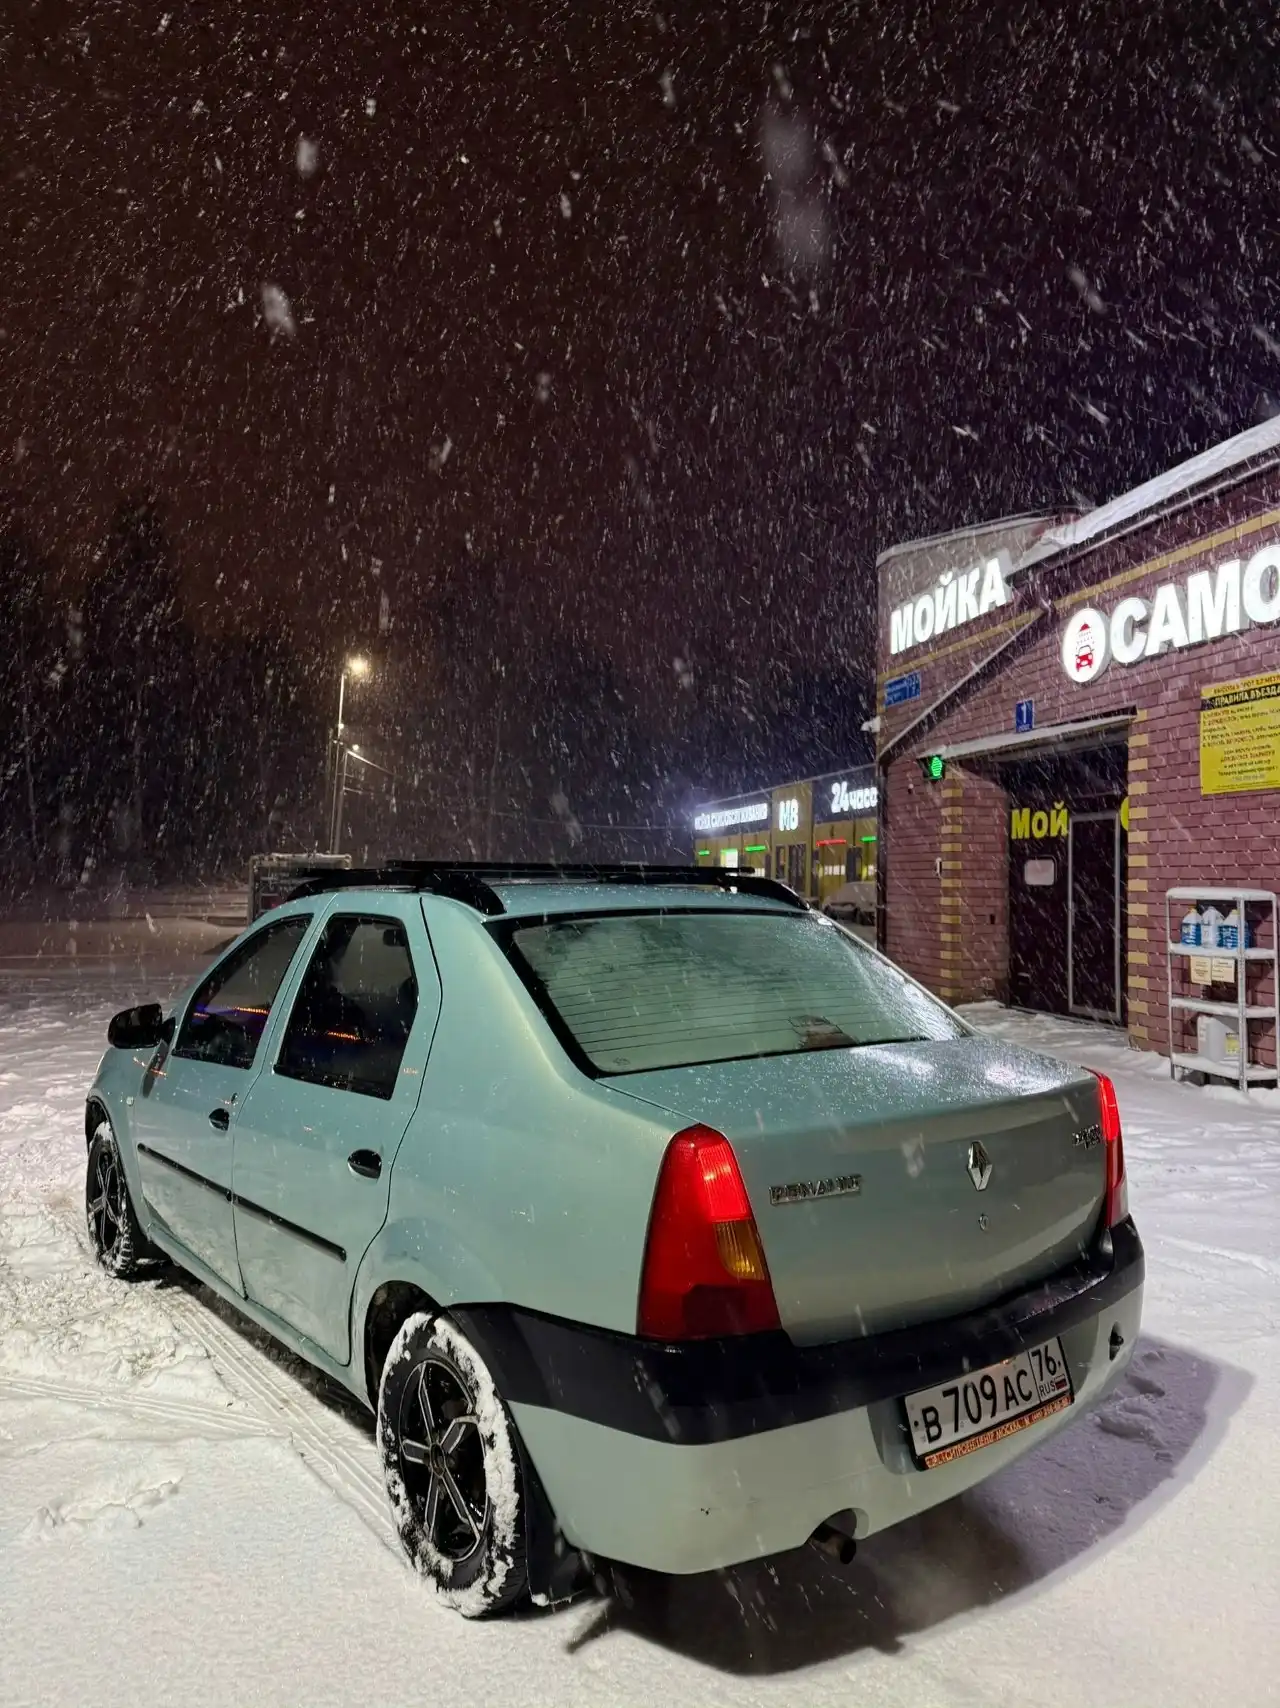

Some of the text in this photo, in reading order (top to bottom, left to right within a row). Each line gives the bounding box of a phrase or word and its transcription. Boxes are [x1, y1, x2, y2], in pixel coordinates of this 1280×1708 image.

[890, 558, 1007, 654] МОЙКА
[1111, 545, 1280, 664] САМО
[1020, 701, 1027, 724] 1
[831, 781, 849, 813] 24
[1011, 800, 1069, 840] МОЙ
[1031, 1344, 1058, 1382] 76
[1039, 1381, 1056, 1398] RUS
